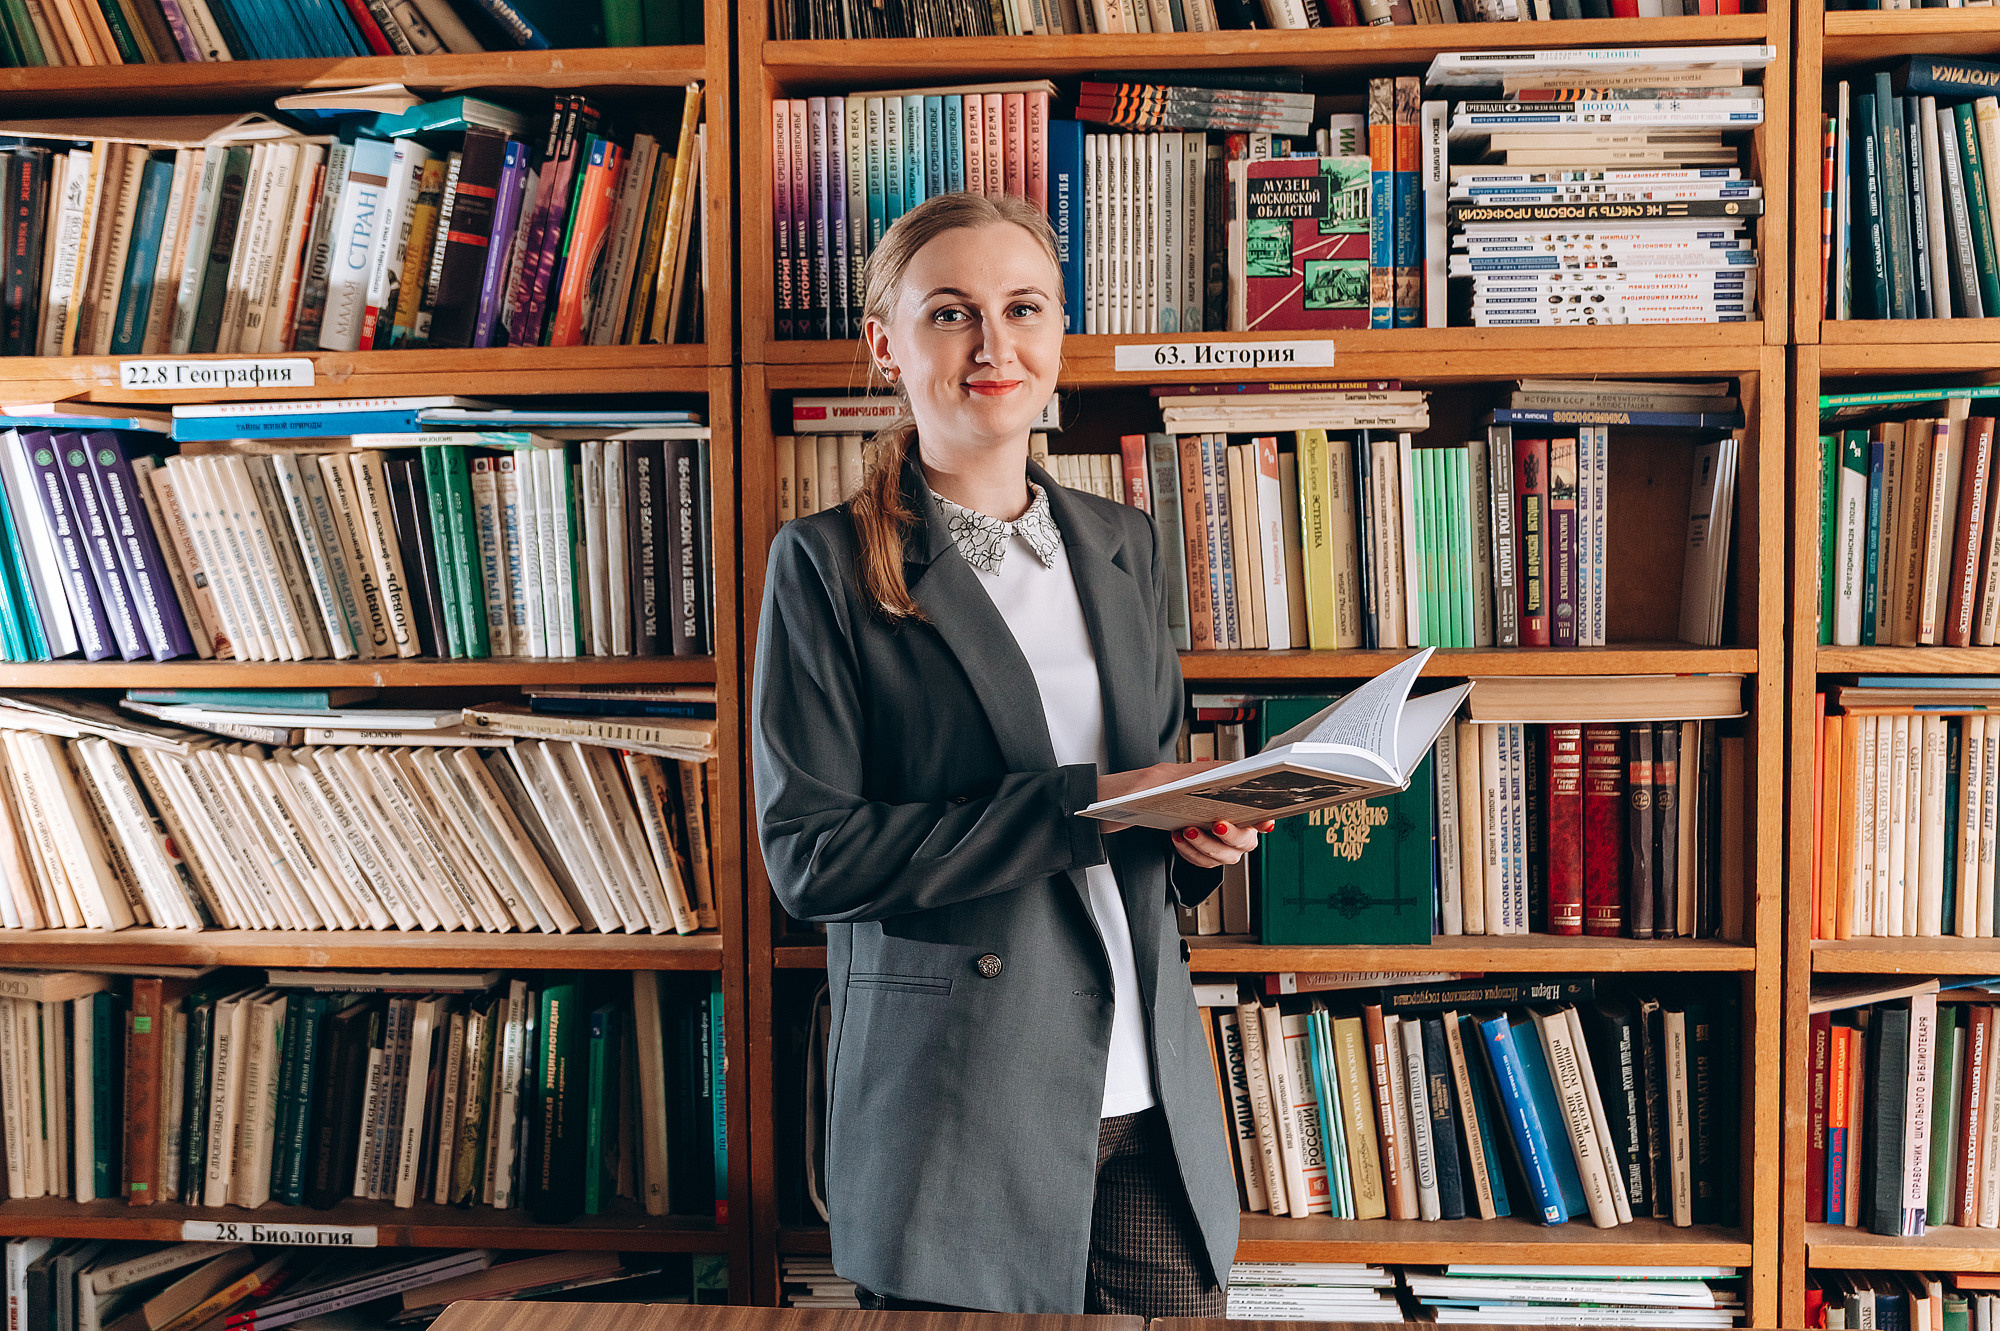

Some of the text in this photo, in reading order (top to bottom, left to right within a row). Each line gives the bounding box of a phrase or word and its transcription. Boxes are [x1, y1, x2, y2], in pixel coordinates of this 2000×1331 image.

[1587, 49, 1641, 60] ЧЕЛОВЕК
[1008, 102, 1018, 132] ВЕКА
[1030, 103, 1040, 132] ВЕКА
[1466, 103, 1505, 113] ОЧЕВИДЕЦ
[1582, 101, 1630, 113] ПОГОДА
[775, 112, 786, 181] СРЕДНЕВЕКОВЬЕ
[868, 110, 880, 194] ДРЕВНИЙ МИР
[887, 109, 898, 194] ДРЕВНИЙ МИР
[928, 107, 939, 172] СРЕДНЕВЕКОВЬЕ
[948, 106, 959, 170] СРЕДНЕВЕКОВЬЕ
[968, 104, 980, 192] НОВОЕ ВРЕМЯ
[988, 106, 999, 193] НОВОЕ ВРЕМЯ
[777, 182, 786, 214] РАННЕЕ
[1250, 190, 1321, 205] МОСКОВСКОЙ
[1262, 178, 1310, 192] МУЗЕИ
[347, 191, 378, 270] СТРАН
[1257, 206, 1313, 218] ОБЛАСТИ
[1458, 204, 1662, 220] НЕ СЧЕСТЬ У РОБОТА ПРОФЕССИЙ
[1944, 130, 1976, 296] НОВОЕ ПЕДАГОГИЧЕСКОЕ МЫШЛЕНИЕ
[310, 243, 330, 281] 1000
[782, 258, 791, 309] ИСТОРИЯ
[335, 281, 356, 336] МАЛАЯ
[128, 365, 292, 388] 22.8 География
[1154, 345, 1295, 367] 63. История
[1268, 382, 1368, 391] Занимательная химия
[1524, 395, 1585, 405] ИСТОРИЯ СССР
[1552, 411, 1630, 424] ЭКОНОМИКА
[1200, 441, 1212, 477] ДУБНА
[330, 465, 348, 510] географии
[1204, 491, 1214, 516] ВЫП.
[343, 512, 366, 561] физической
[540, 513, 557, 586] ЭВОЛЮЦИЯ
[554, 512, 571, 586] ЭВОЛЮЦИЯ
[640, 508, 653, 544] МОРЕ
[1904, 442, 1926, 620] РАБОЧАЯ КНИГА ШКОЛЬНОГО ПСИХОЛОГА
[1958, 432, 1988, 634] ЭСТЕТИЧЕСКОЕ ВОСПИТАНИЕ ШКОЛЬНОЙ МОЛОДЕЖИ
[477, 504, 504, 626] ПОД ЛУЧАМИ ГЕЛИОСА
[503, 503, 525, 626] ПОД ЛУЧАМИ ГЕЛИОСА
[524, 514, 540, 588] ЭВОЛЮЦИЯ
[642, 545, 654, 564] НА
[643, 566, 656, 576] И
[1271, 520, 1282, 584] Мученики веры
[1559, 514, 1569, 600] ВСЕМИРНАЯ ИСТОРИЯ
[642, 578, 656, 616] СУШЕ
[1988, 570, 1998, 592] ШАГИ
[358, 573, 388, 646] Словарь
[646, 618, 656, 636] НА
[1210, 572, 1224, 643] МОСКОВСКАЯ
[1984, 596, 1996, 626] ПЕРВЫЕ
[1894, 730, 1906, 760] ИЗО
[1910, 747, 1920, 771] ИЗО
[1440, 734, 1452, 819] НОВОЙ ИСТОРИИ
[1876, 740, 1890, 854] ЗДРАВСТВУЙТЕ, ДЕТИ
[1967, 738, 1979, 831] ДЕТИ БЕЗ РОДИТЕЛЕЙ
[1984, 738, 1996, 831] ДЕТИ БЕЗ РОДИТЕЛЕЙ
[312, 768, 400, 910] УРОКИ ОБЩЕЙ БИОЛОГИИ
[1332, 842, 1364, 862] году
[1343, 824, 1371, 845] 1812
[1305, 972, 1379, 986] ОТЕЧЕСТВА
[1392, 984, 1560, 1007] Н.Верт История советского государства
[1837, 1038, 1846, 1070] ЛЮДЬМИ
[541, 1000, 560, 1190] ЭКОНОМИЧЕСКАЯ ЭНЦИКЛОПЕДИЯ
[1225, 1023, 1256, 1140] НАША МОСКВА
[1410, 1062, 1422, 1100] ШКОЛЕ
[1552, 1039, 1589, 1158] ГЕРОИЧЕСКИЕ СТРАНИЦЫ
[1564, 1046, 1591, 1134] ИСТОРИИ РОДИНЫ
[1813, 1029, 1826, 1150] ДАРИТЕ ЛЮДЯМ КРАСОТУ
[1836, 1071, 1846, 1120] НЕПОХОЖИМИ
[1414, 1110, 1426, 1140] ТРУДА
[1697, 1056, 1710, 1165] ХРЕСТОМАТИЯ
[1912, 1016, 1930, 1200] СПРАВОЧНИК ШКОЛЬНОГО БИБЛИОТЕКАРЯ
[1302, 1107, 1320, 1166] РОССИИ
[1416, 1142, 1430, 1181] ОХРАНА
[1832, 1155, 1842, 1212] ИСКУССТВО
[216, 1223, 353, 1245] 28. Биология
